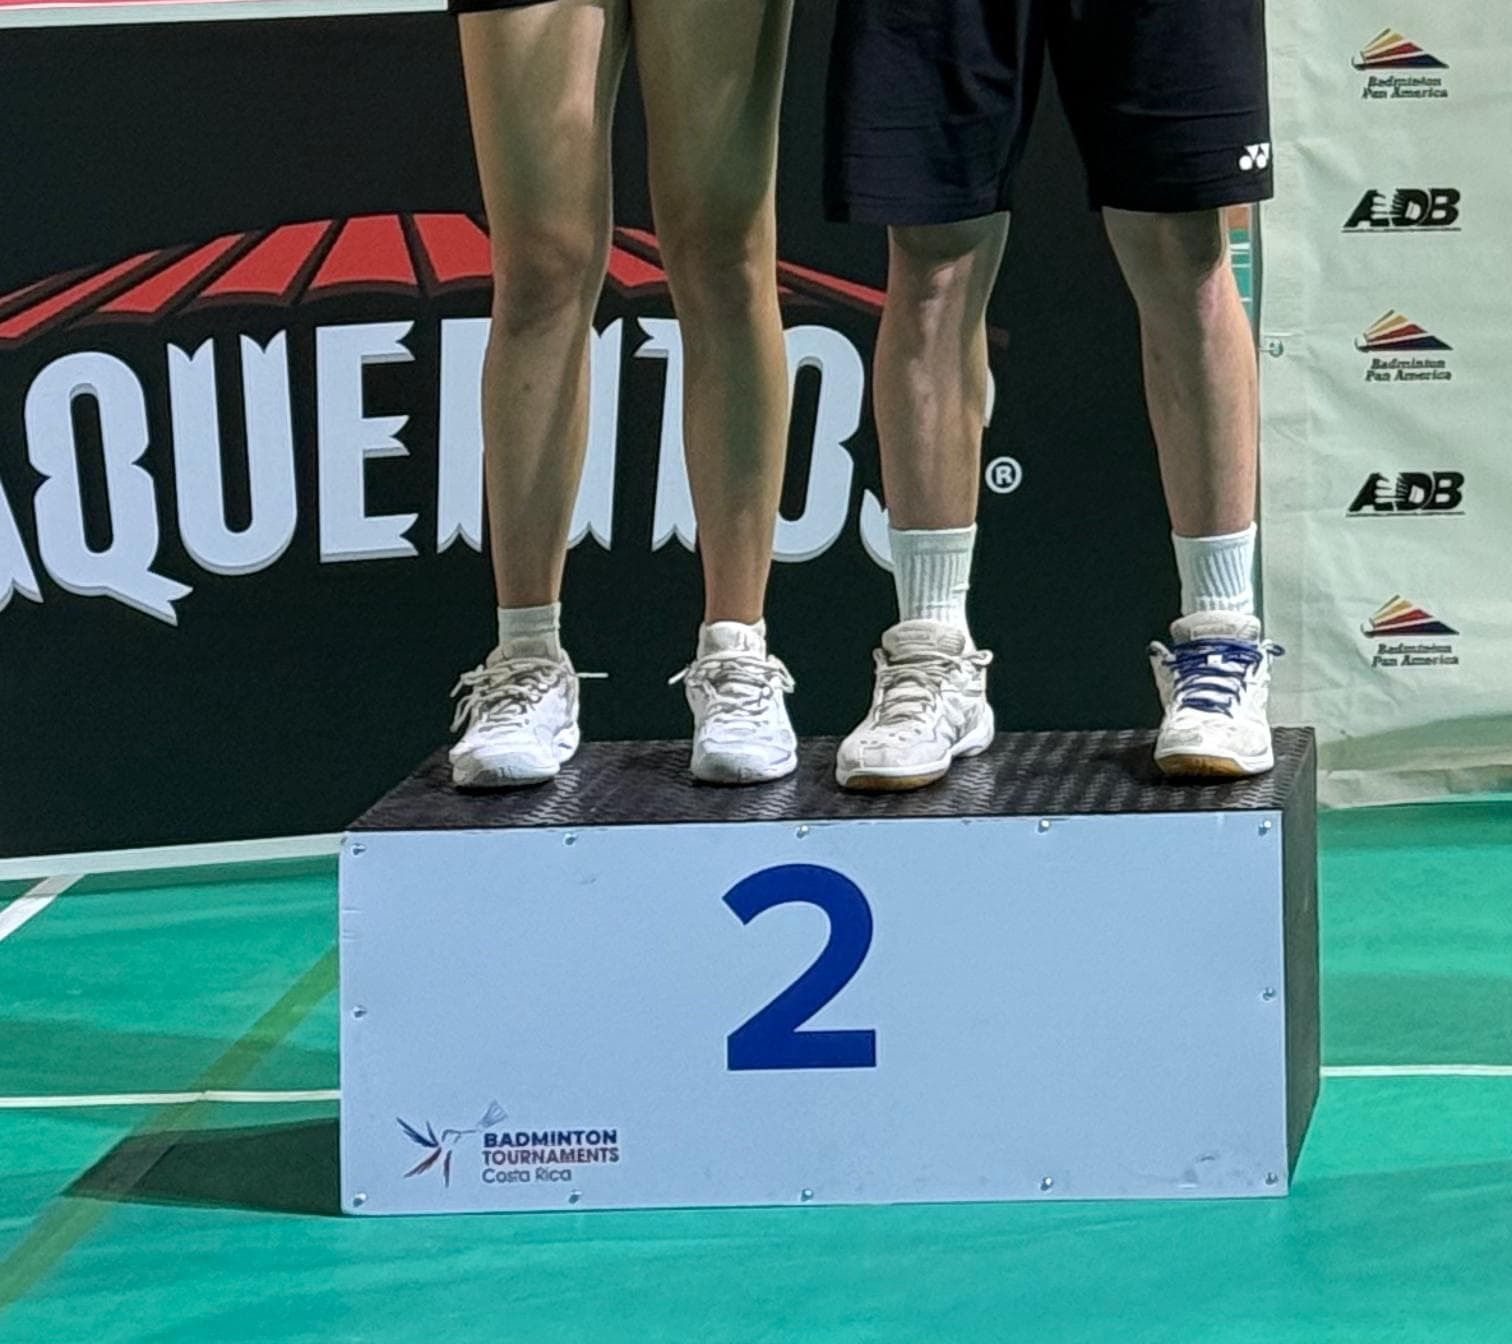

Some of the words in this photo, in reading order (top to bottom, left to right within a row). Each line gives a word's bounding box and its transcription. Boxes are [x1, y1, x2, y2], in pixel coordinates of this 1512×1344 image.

[721, 863, 877, 1071] 2
[483, 1129, 617, 1148] BADMINTON
[482, 1147, 620, 1166] TOURNAMENTS
[482, 1168, 530, 1184] Costa
[535, 1166, 571, 1182] Rica
